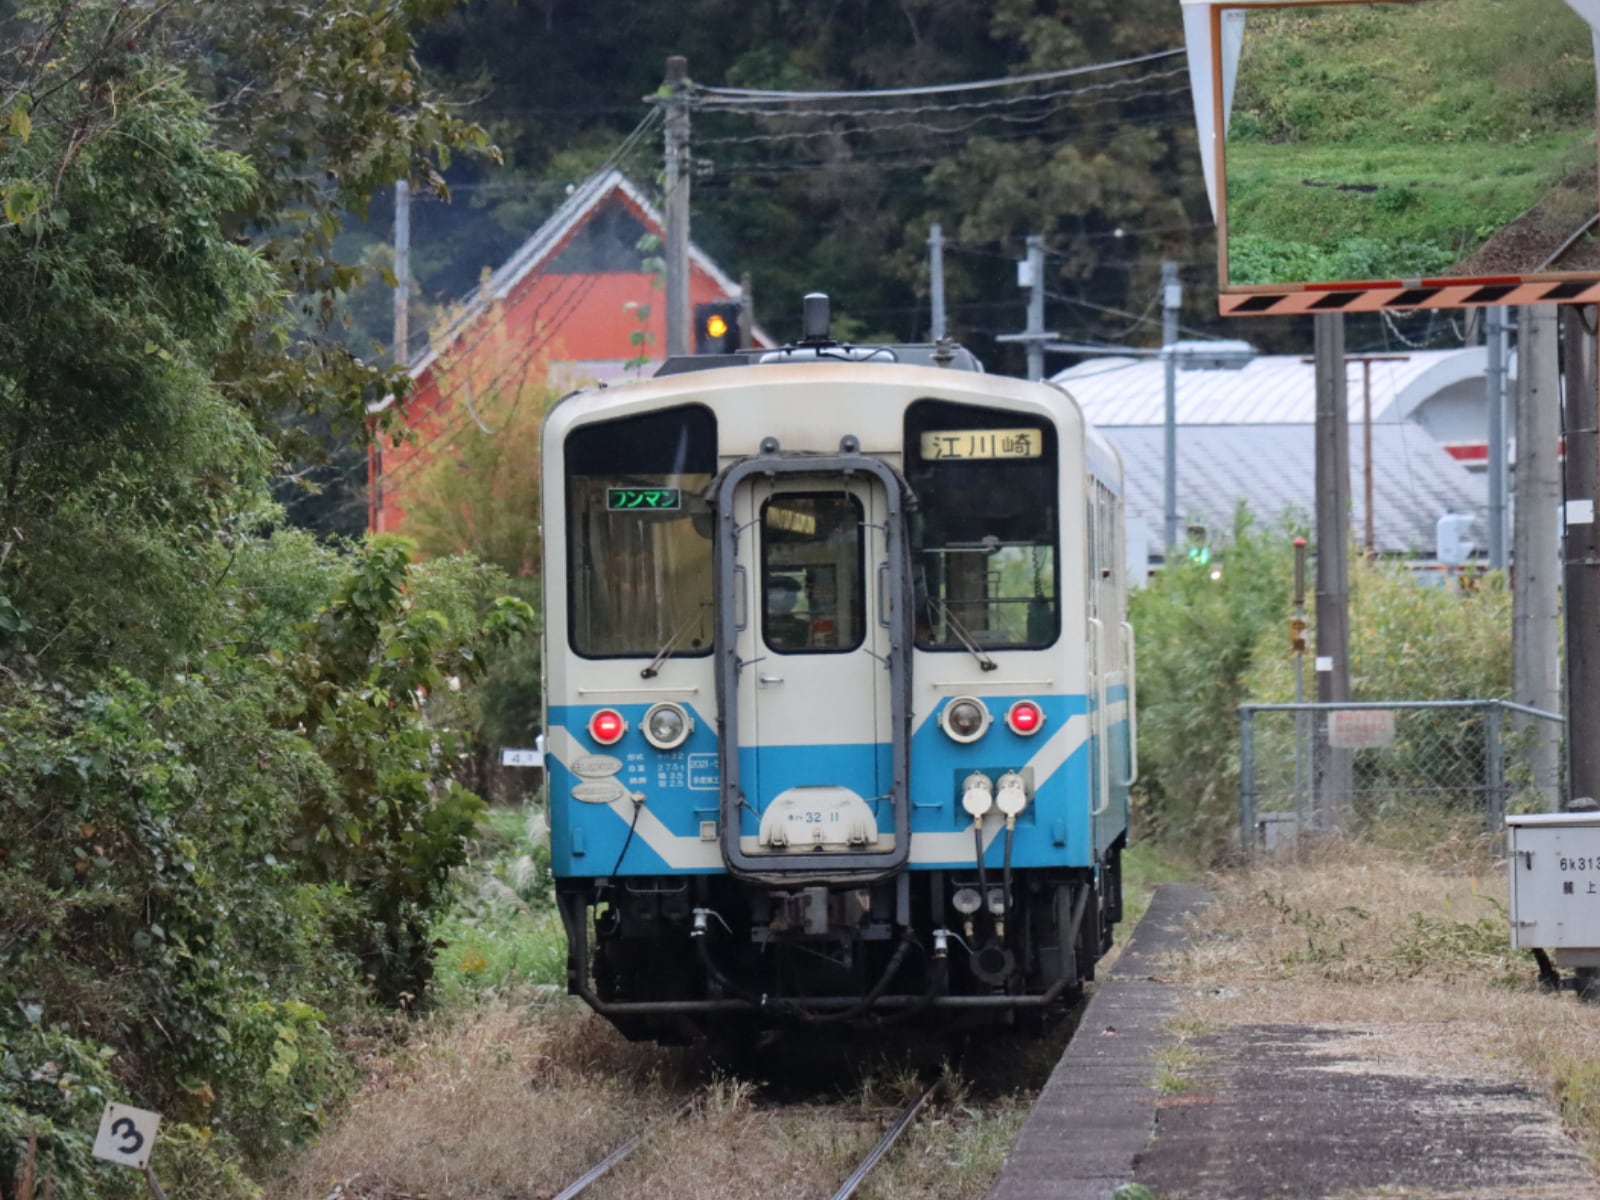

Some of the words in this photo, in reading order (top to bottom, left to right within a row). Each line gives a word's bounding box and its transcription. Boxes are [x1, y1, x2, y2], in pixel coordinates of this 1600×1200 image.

[932, 433, 1031, 458] 江川崎
[610, 490, 677, 508] ワンマン
[805, 811, 822, 823] 32
[111, 1117, 144, 1154] 3
